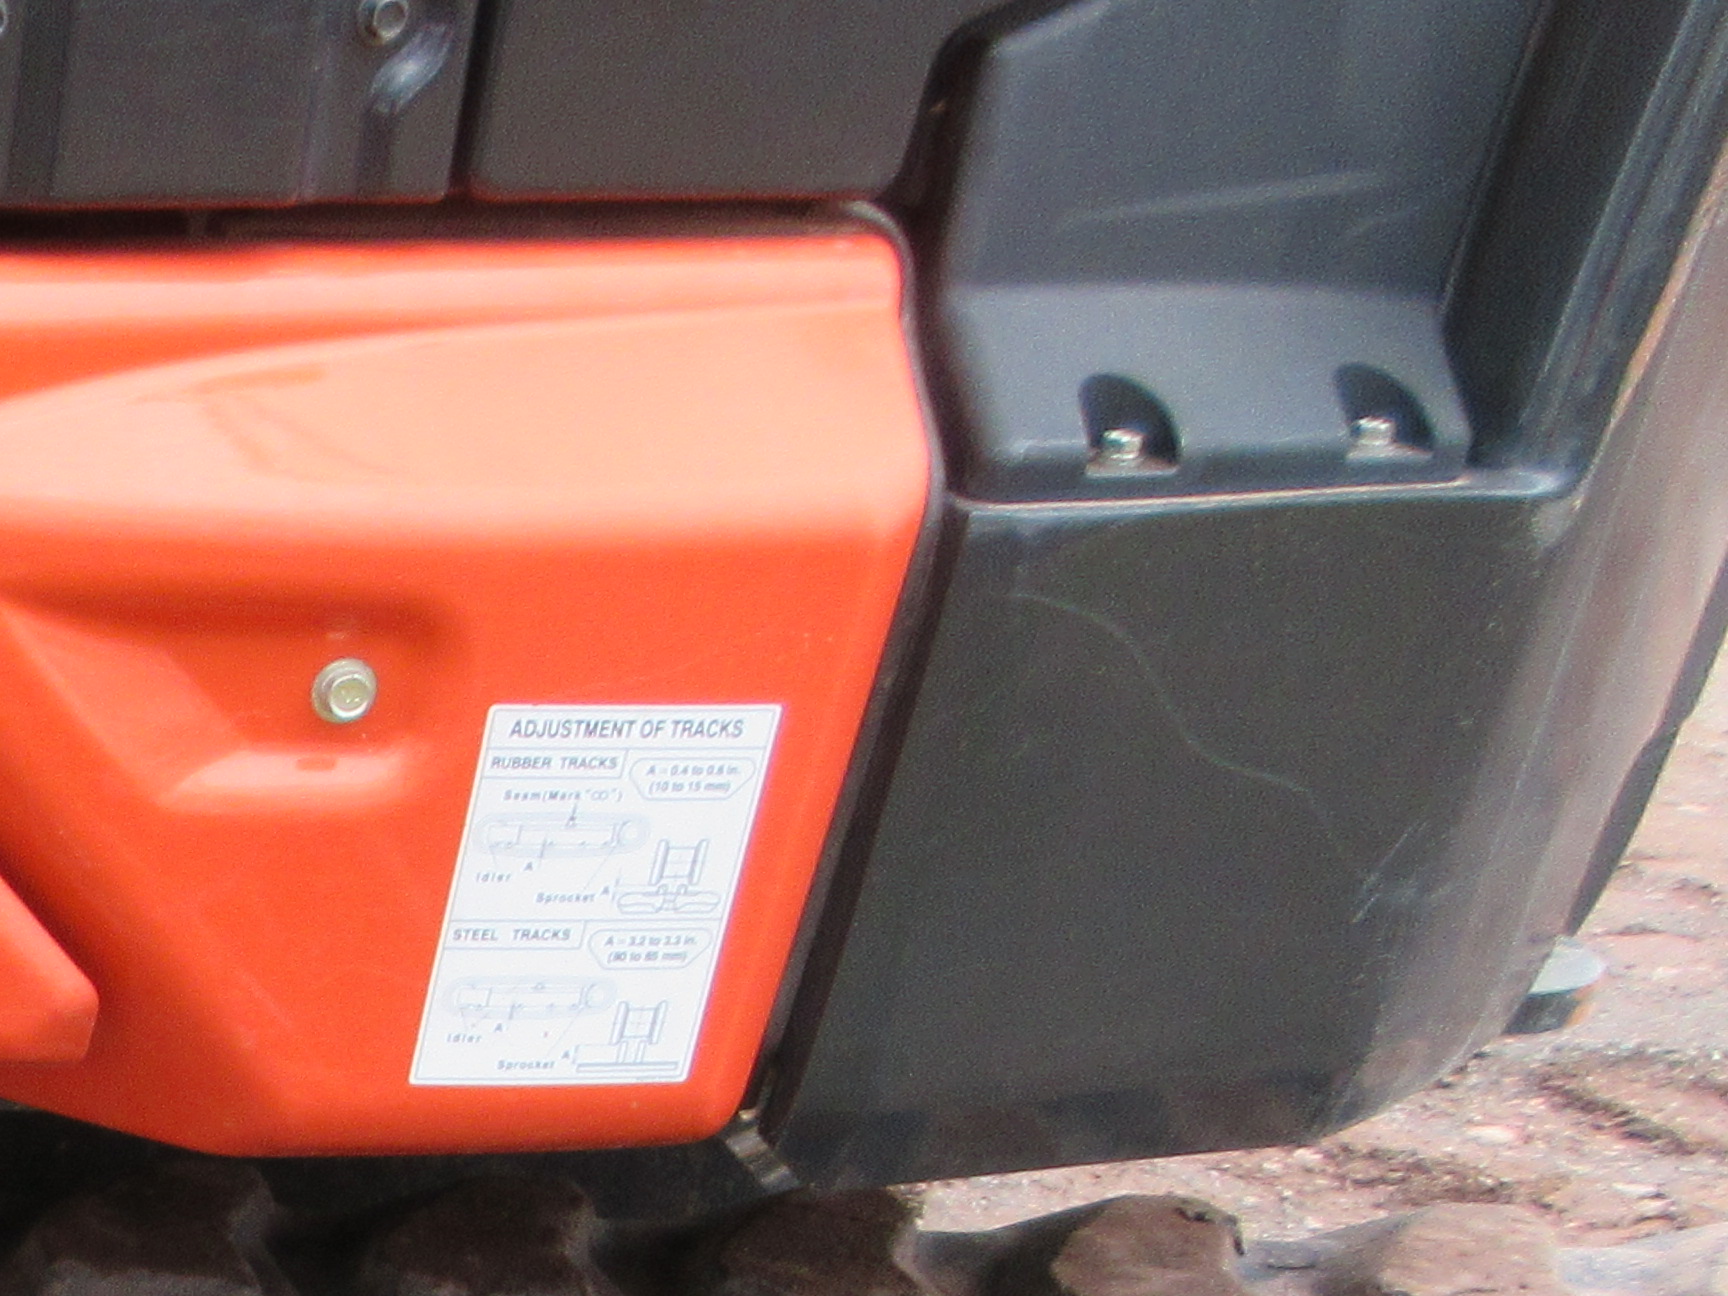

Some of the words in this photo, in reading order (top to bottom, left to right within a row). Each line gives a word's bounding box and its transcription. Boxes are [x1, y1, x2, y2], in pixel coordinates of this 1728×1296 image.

[509, 719, 637, 739] ADJUSTMENT
[640, 719, 665, 739] OF
[671, 719, 744, 739] TRACKS
[490, 756, 552, 770] RUBBER
[560, 757, 618, 770] TRACKS
[691, 765, 704, 776] to
[648, 780, 670, 796] (10
[672, 781, 685, 793] to
[476, 872, 511, 883] Idler
[536, 892, 596, 904] Sprocket
[452, 928, 498, 941] STEEL
[512, 928, 572, 941] TRACKS
[447, 1033, 482, 1044] Idler
[497, 1059, 556, 1071] Sprocket
